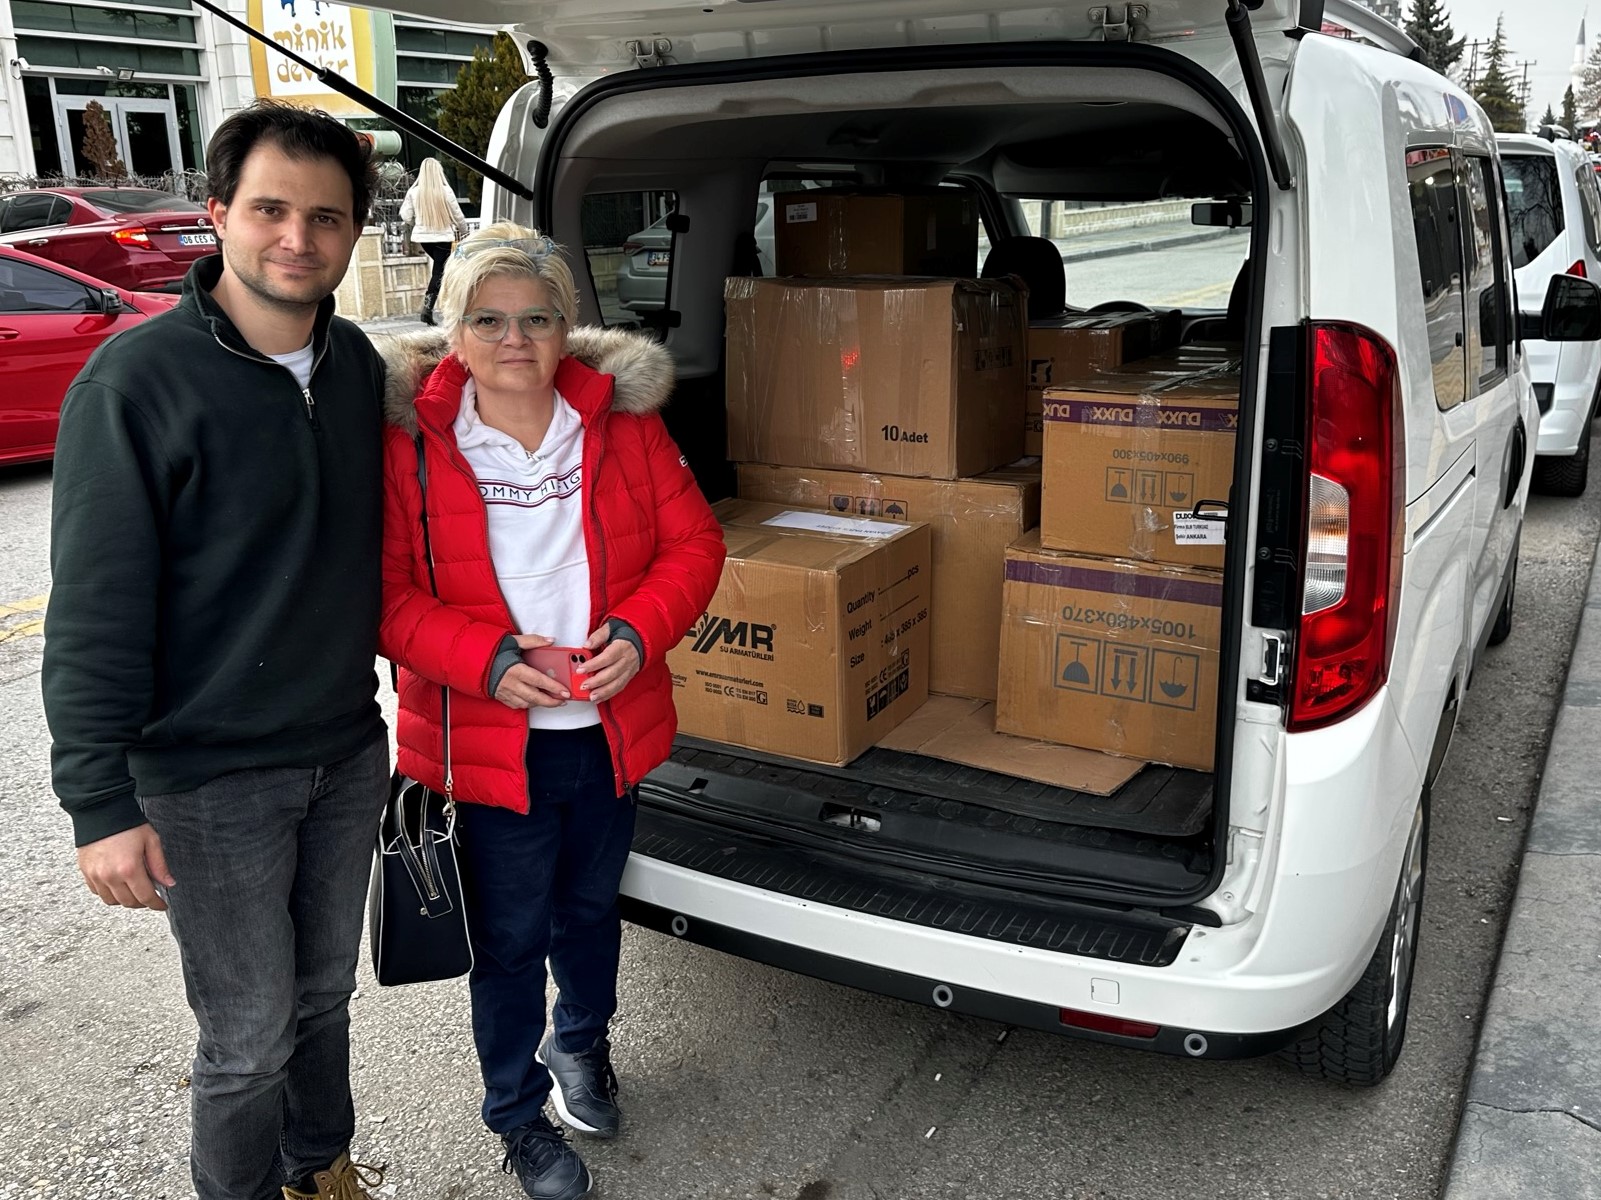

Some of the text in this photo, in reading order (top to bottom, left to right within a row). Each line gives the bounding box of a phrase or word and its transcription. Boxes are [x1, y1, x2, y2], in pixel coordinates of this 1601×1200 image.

[273, 21, 347, 52] minik
[1092, 406, 1134, 422] DUXX
[1158, 410, 1201, 426] DUXX
[881, 425, 928, 443] 10 Adet
[1112, 449, 1190, 464] 990x405x300
[847, 565, 919, 613] Quantity pcs
[848, 619, 872, 640] Weight
[1062, 605, 1197, 640] 1005x480x370
[719, 645, 728, 653] SU
[850, 653, 864, 668] Size
